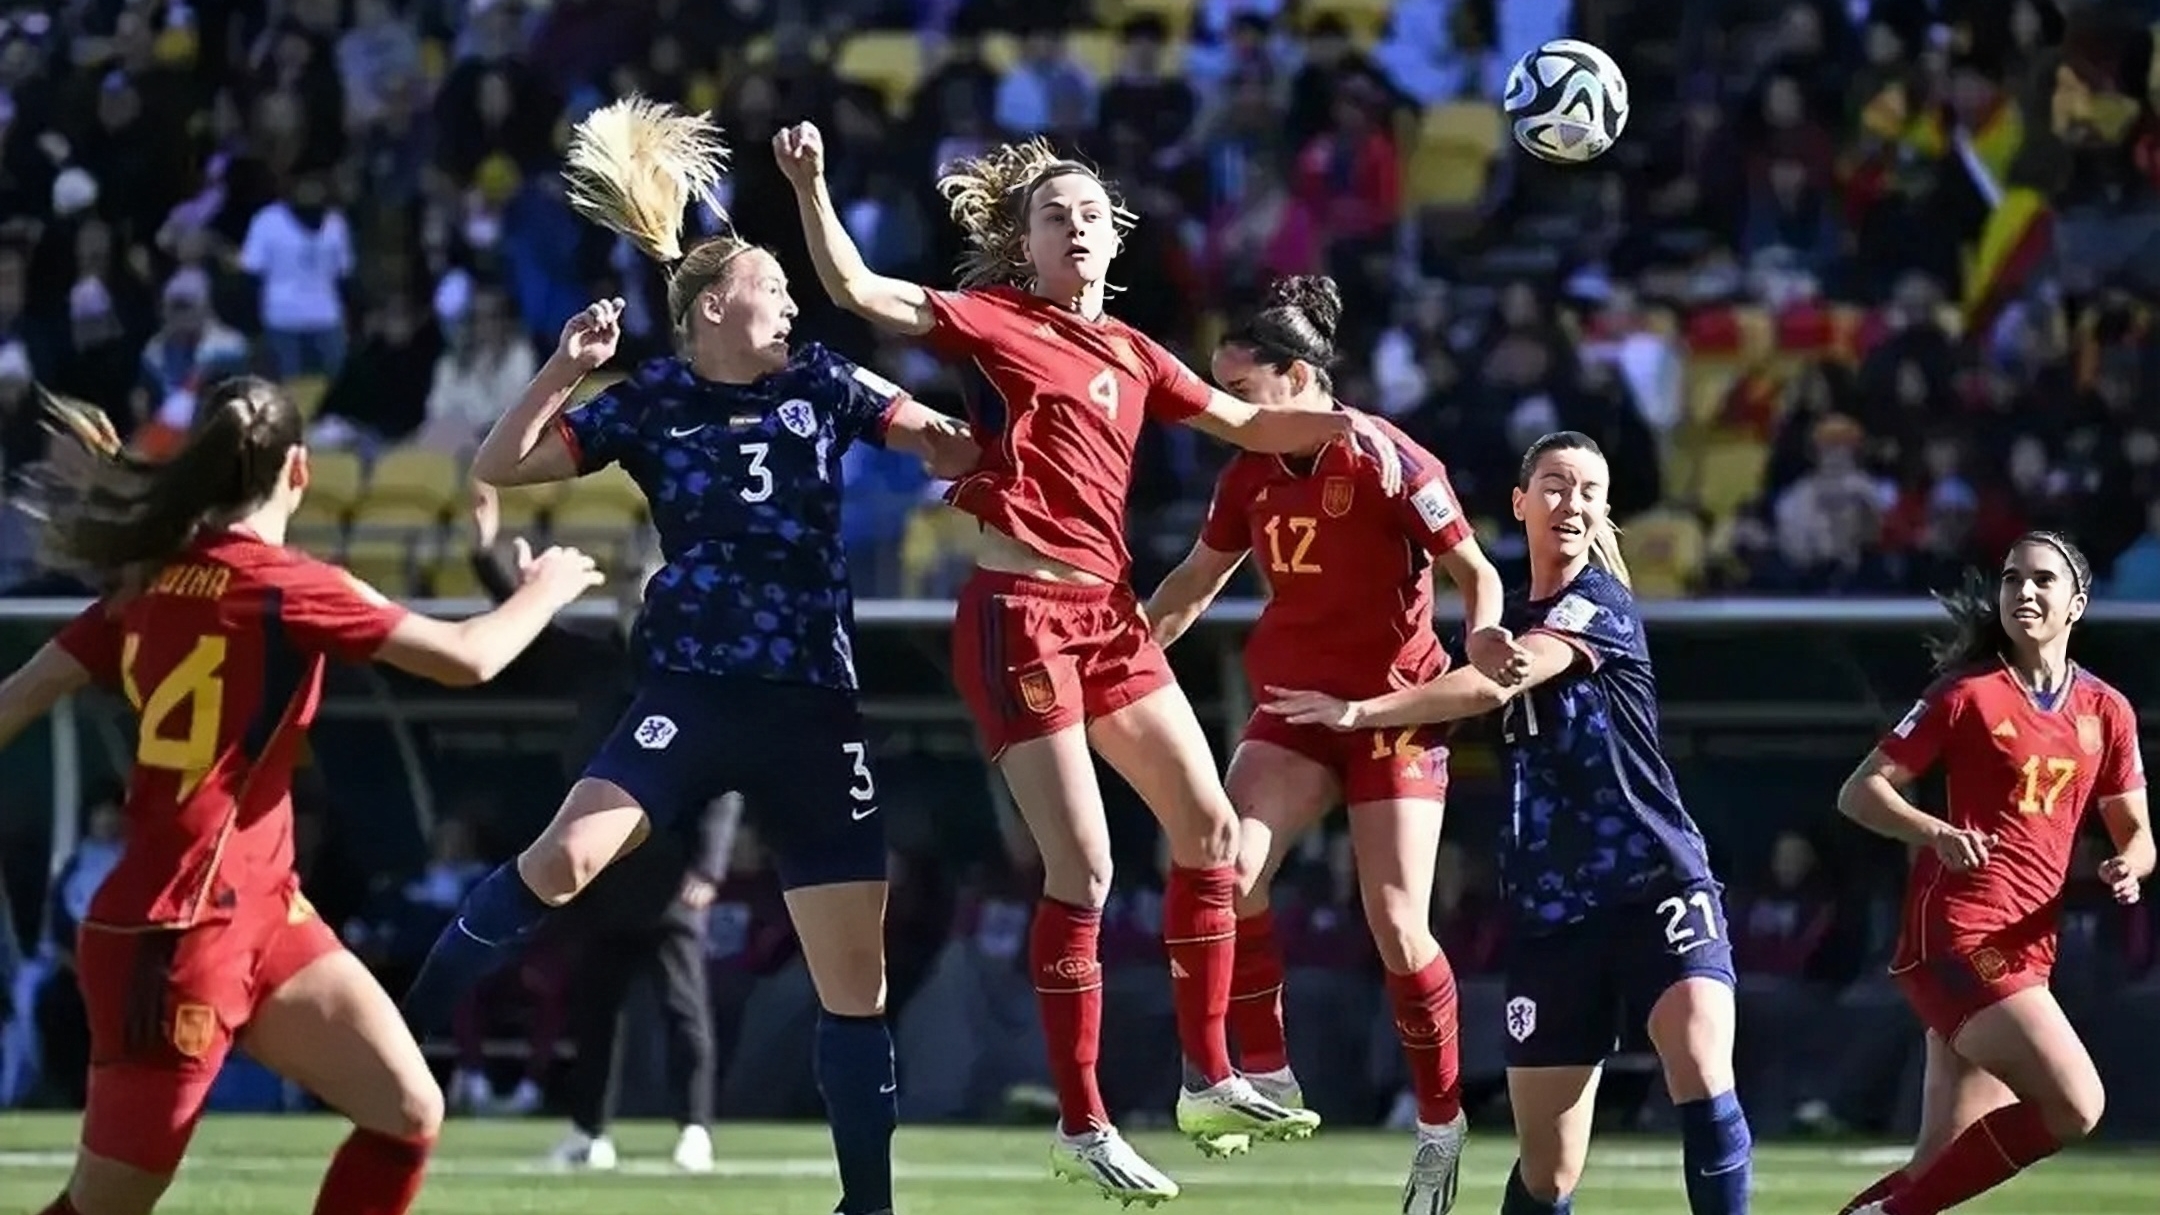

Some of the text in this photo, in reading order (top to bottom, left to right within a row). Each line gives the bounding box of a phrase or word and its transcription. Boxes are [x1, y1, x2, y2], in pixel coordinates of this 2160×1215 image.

[1088, 366, 1119, 421] 4
[739, 442, 773, 502] 3
[1264, 514, 1322, 574] 12
[842, 742, 875, 800] 3
[2018, 754, 2077, 816] 17
[1655, 891, 1719, 944] 21
